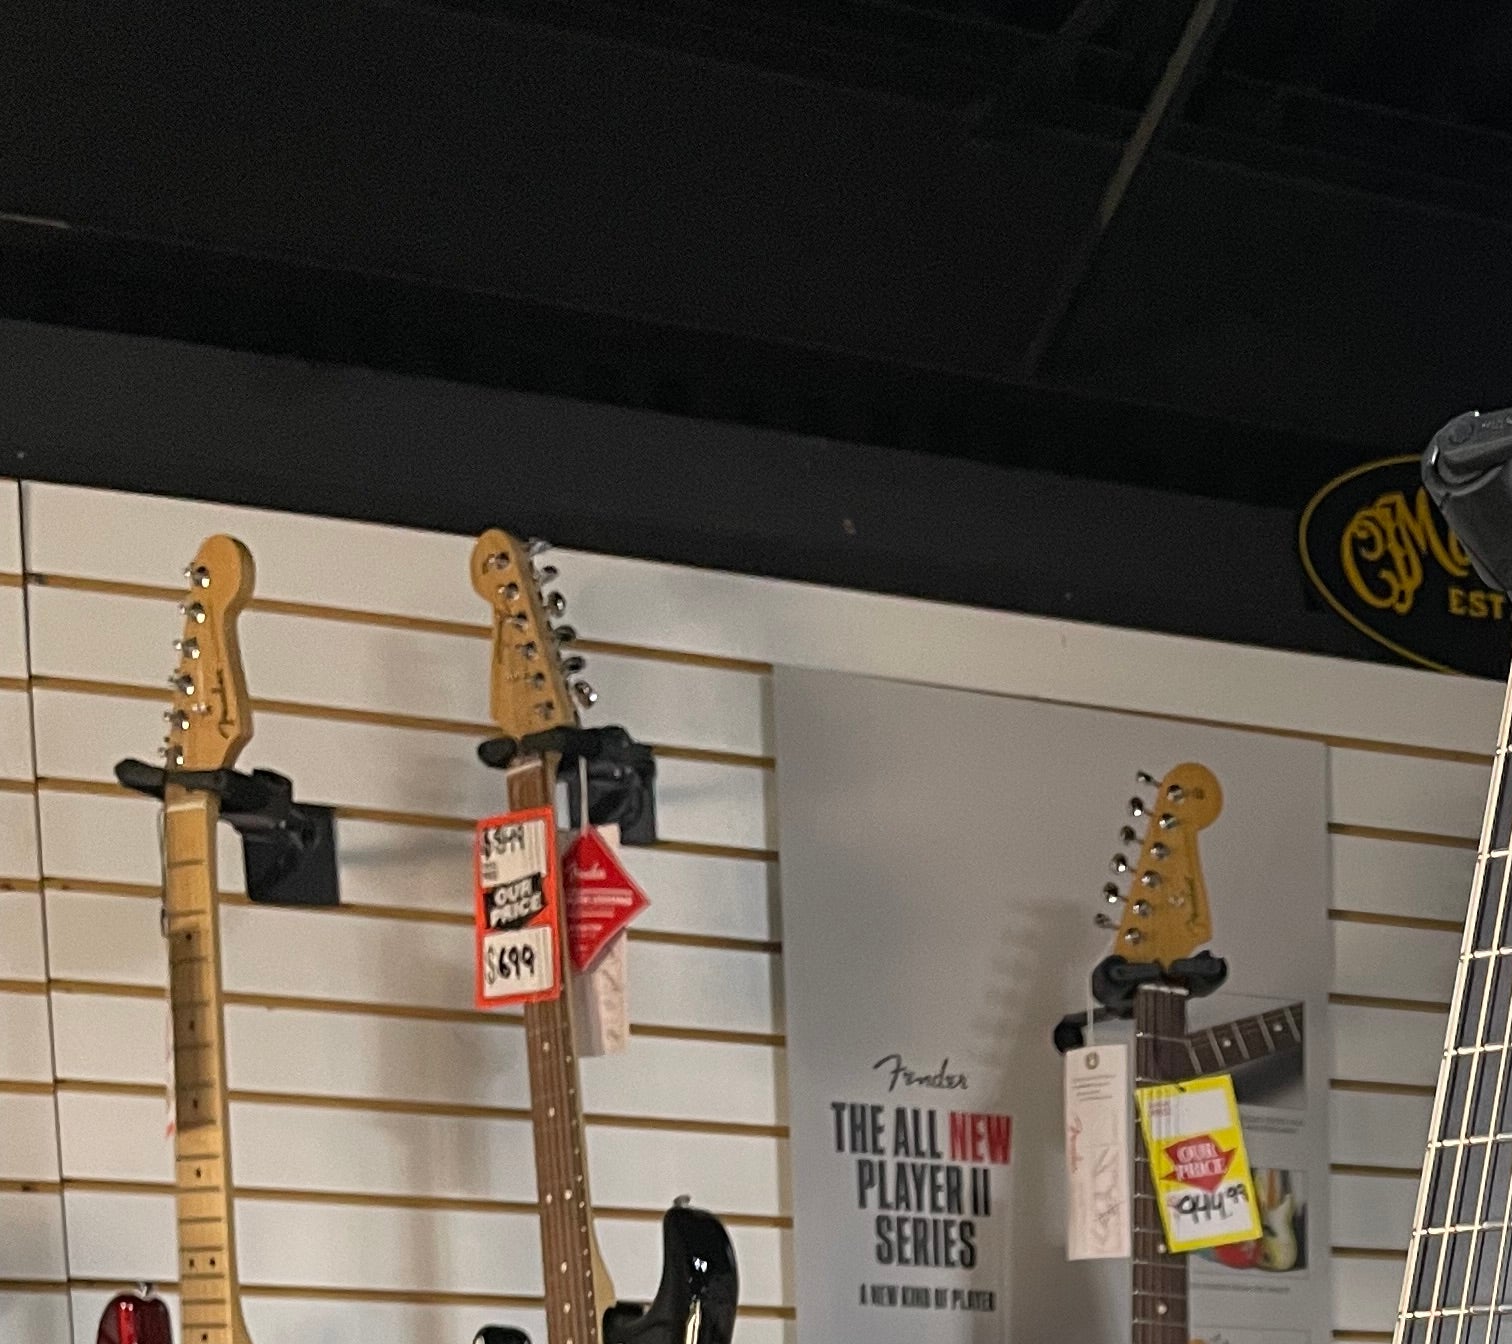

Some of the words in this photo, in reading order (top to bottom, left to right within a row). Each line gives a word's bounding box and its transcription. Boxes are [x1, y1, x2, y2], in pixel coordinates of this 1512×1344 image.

[490, 890, 543, 929] PRICE
[494, 883, 533, 906] OUR
[486, 943, 535, 985] $699
[873, 1054, 969, 1092] Fender
[832, 1102, 886, 1154] THE
[894, 1106, 943, 1159] ALL
[949, 1112, 1012, 1165] NEW
[1175, 1143, 1218, 1163] OUR
[857, 1159, 963, 1216] PLAYER
[971, 1167, 991, 1217] II
[1176, 1157, 1226, 1180] PRICE
[875, 1215, 977, 1269] SERIES
